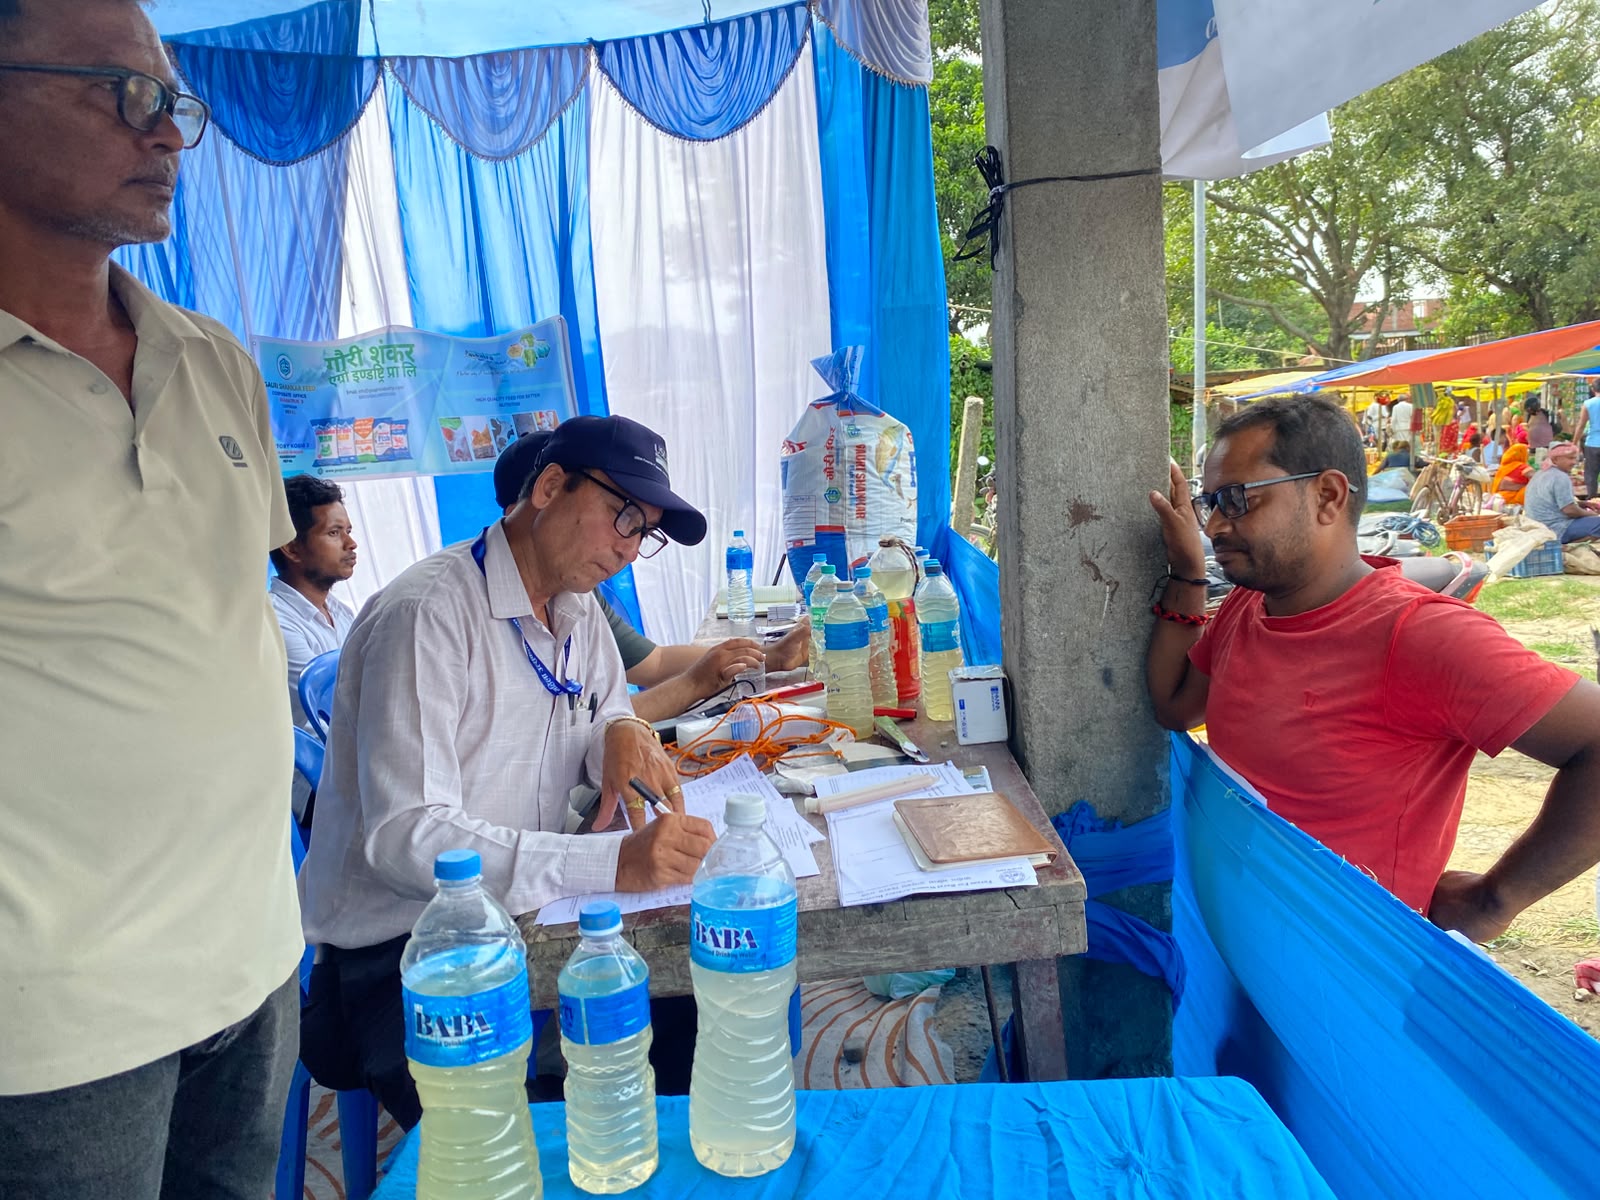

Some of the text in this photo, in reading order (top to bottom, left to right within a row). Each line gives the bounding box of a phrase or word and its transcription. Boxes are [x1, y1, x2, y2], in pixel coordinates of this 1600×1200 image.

[323, 339, 415, 372] गौरी शंकर
[402, 362, 417, 377] लि
[855, 444, 866, 519] GAURI SHANKAR
[694, 920, 759, 949] BABA
[415, 1009, 491, 1037] BABA
